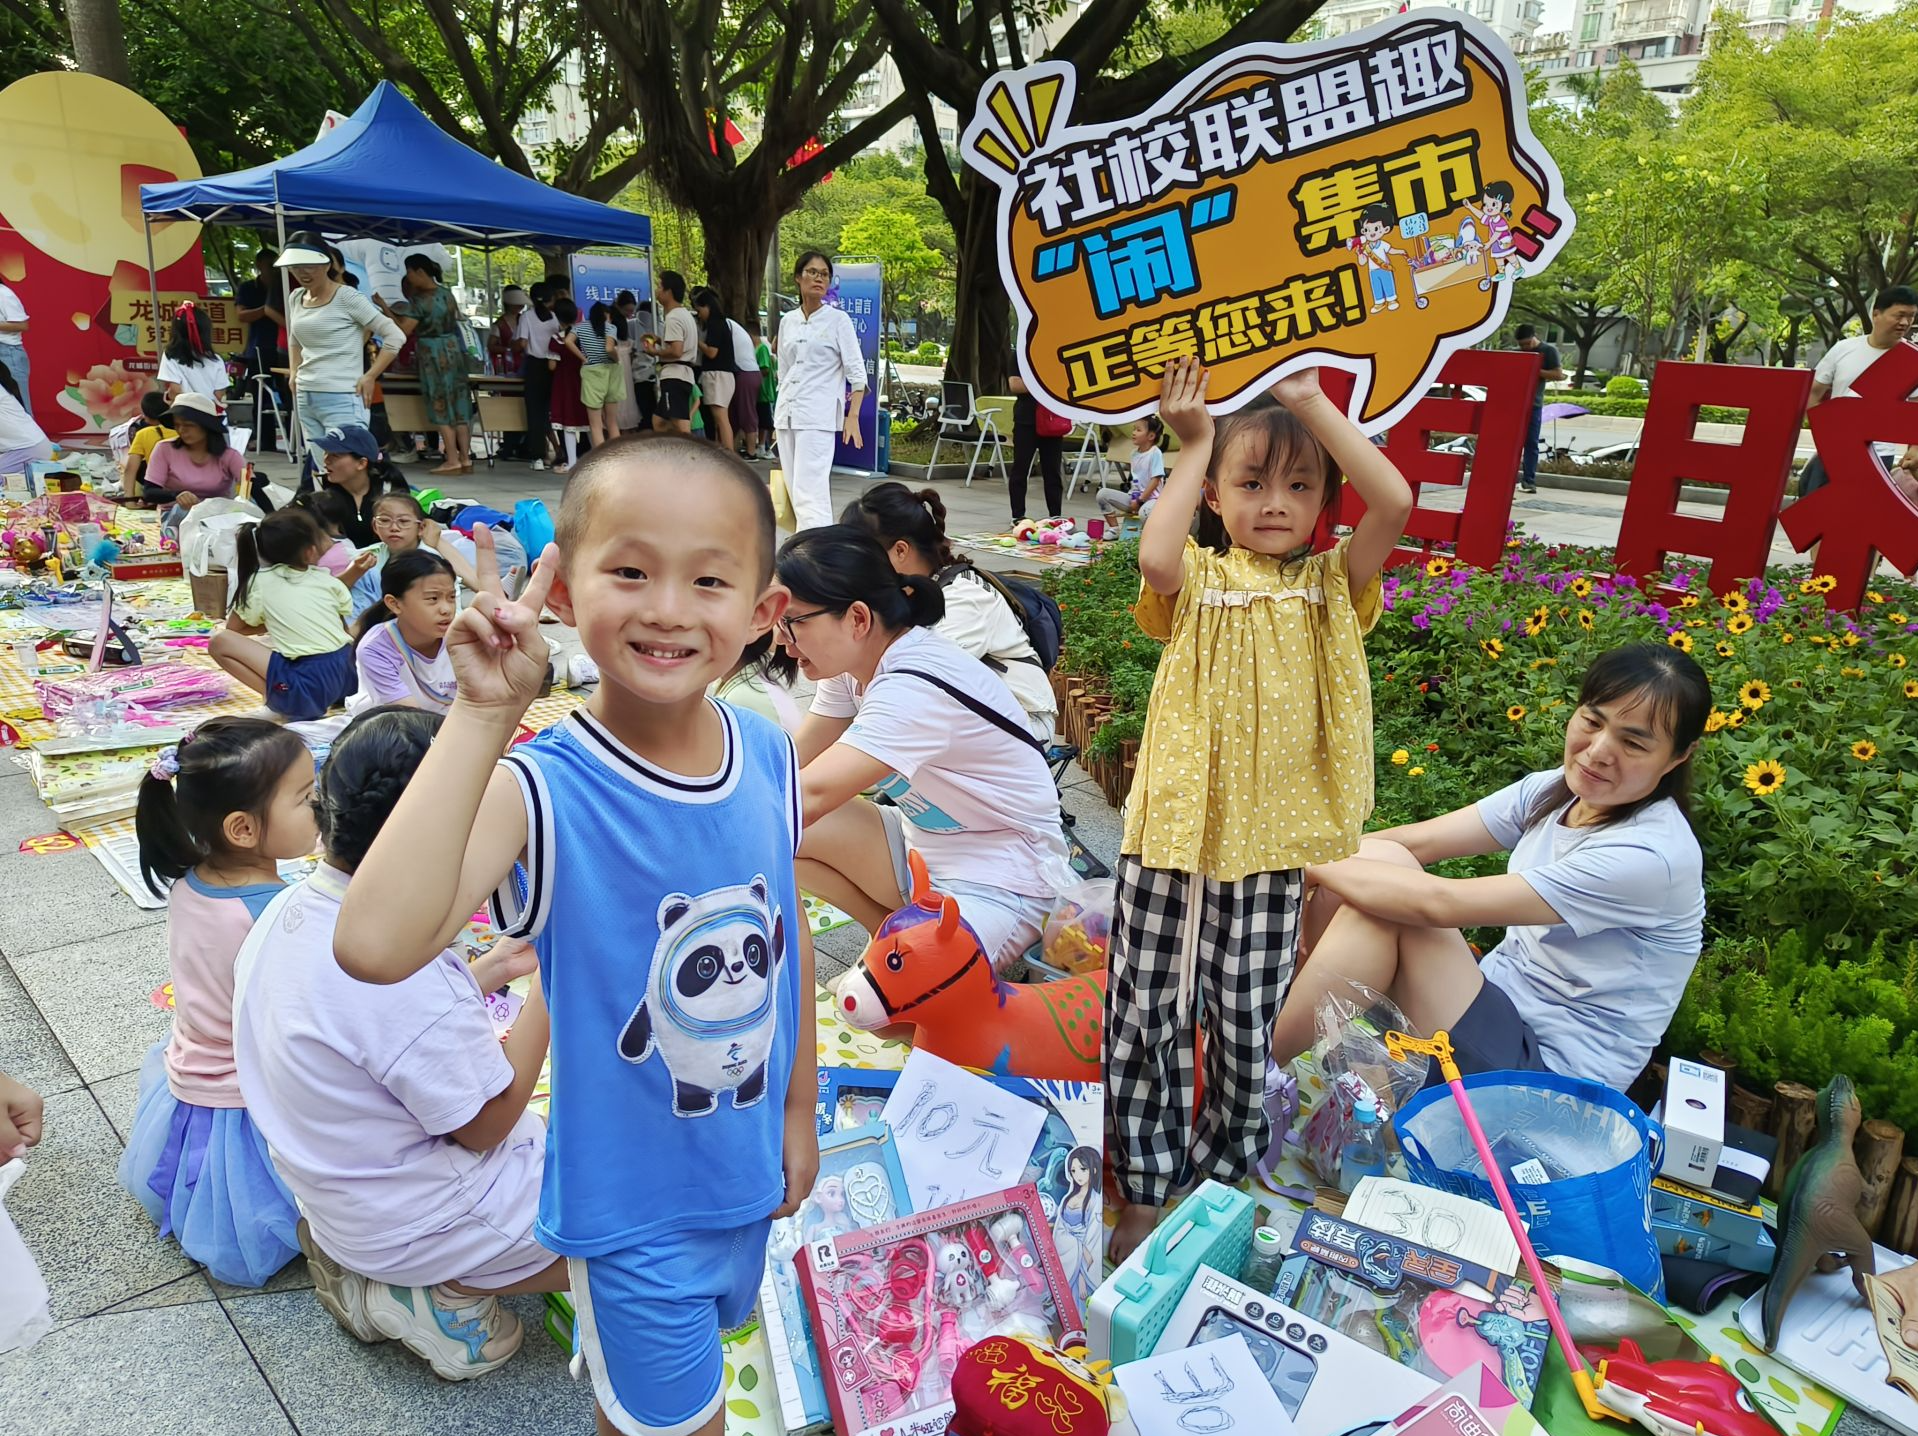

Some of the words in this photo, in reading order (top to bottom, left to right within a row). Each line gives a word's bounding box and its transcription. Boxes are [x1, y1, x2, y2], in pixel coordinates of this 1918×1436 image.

[1024, 29, 1466, 231] 社校联盟趣
[1297, 136, 1478, 250] 集市
[129, 300, 226, 323] 龙城道
[1022, 1188, 1036, 1200] 3+
[985, 1363, 1045, 1411] 福
[1443, 1400, 1491, 1436] 尚迪
